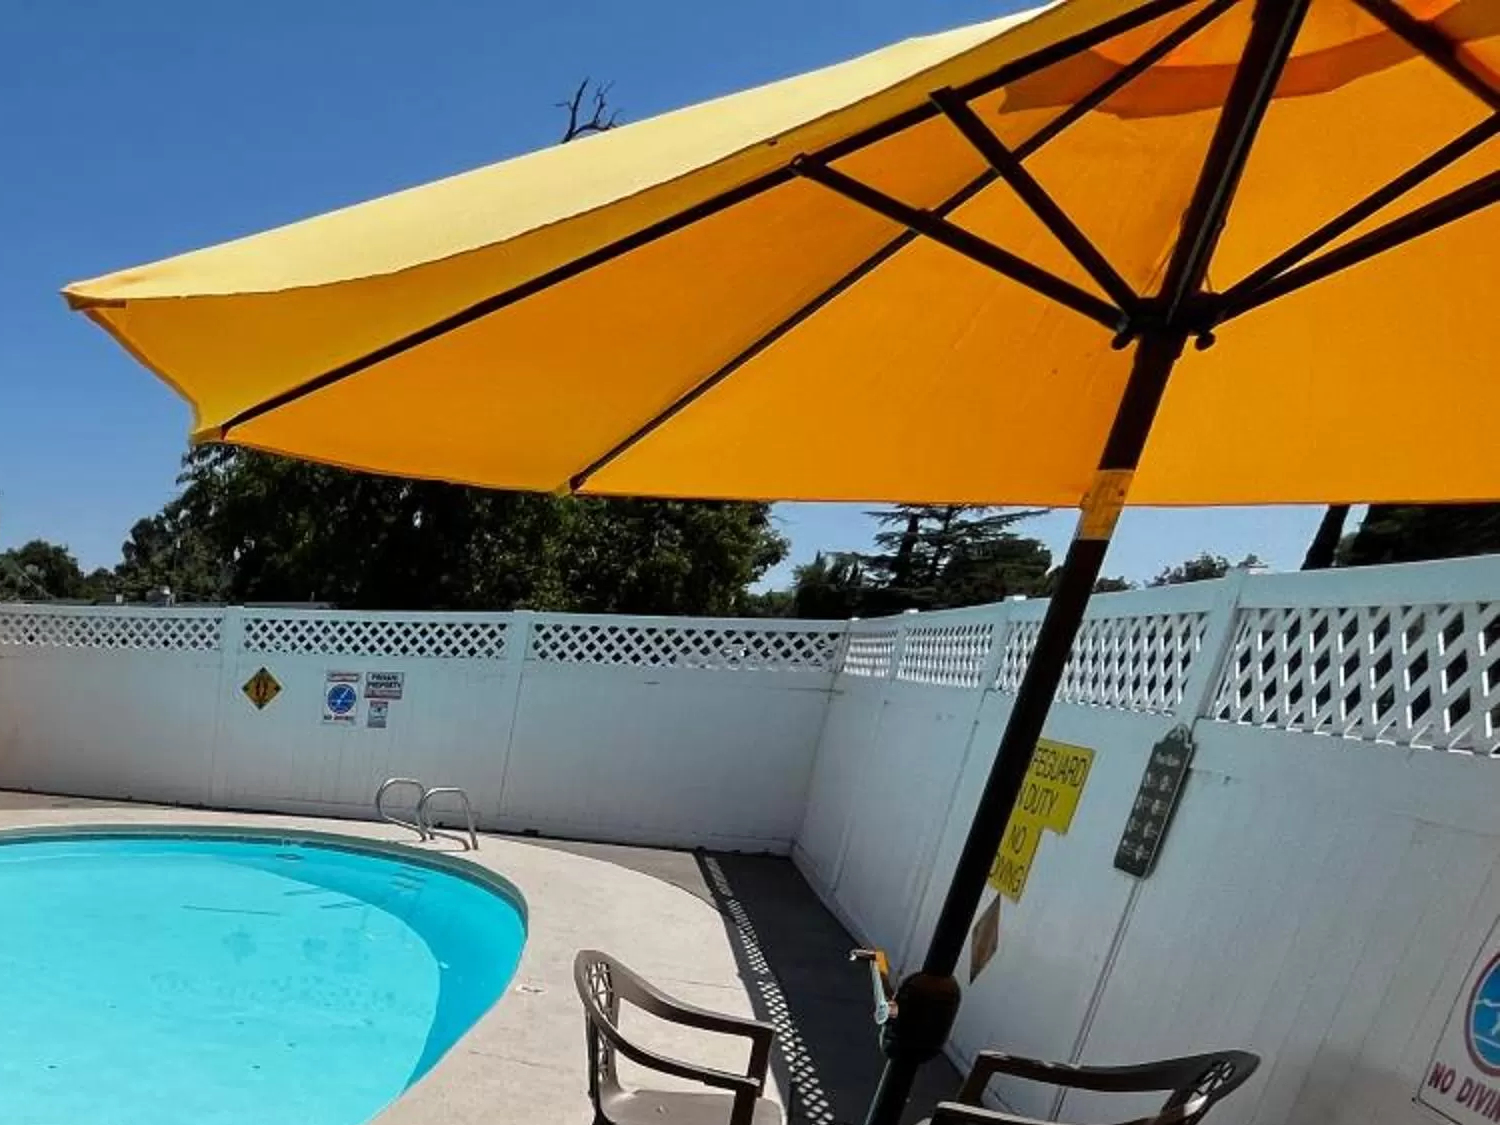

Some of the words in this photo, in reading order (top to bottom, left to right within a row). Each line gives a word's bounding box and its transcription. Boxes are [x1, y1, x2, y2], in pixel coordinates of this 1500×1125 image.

[1031, 746, 1089, 788] FEGUARD
[1023, 783, 1060, 816] DUTY
[1006, 824, 1028, 855] NO
[1427, 1061, 1457, 1095] NO
[1455, 1075, 1500, 1124] DIVIN
